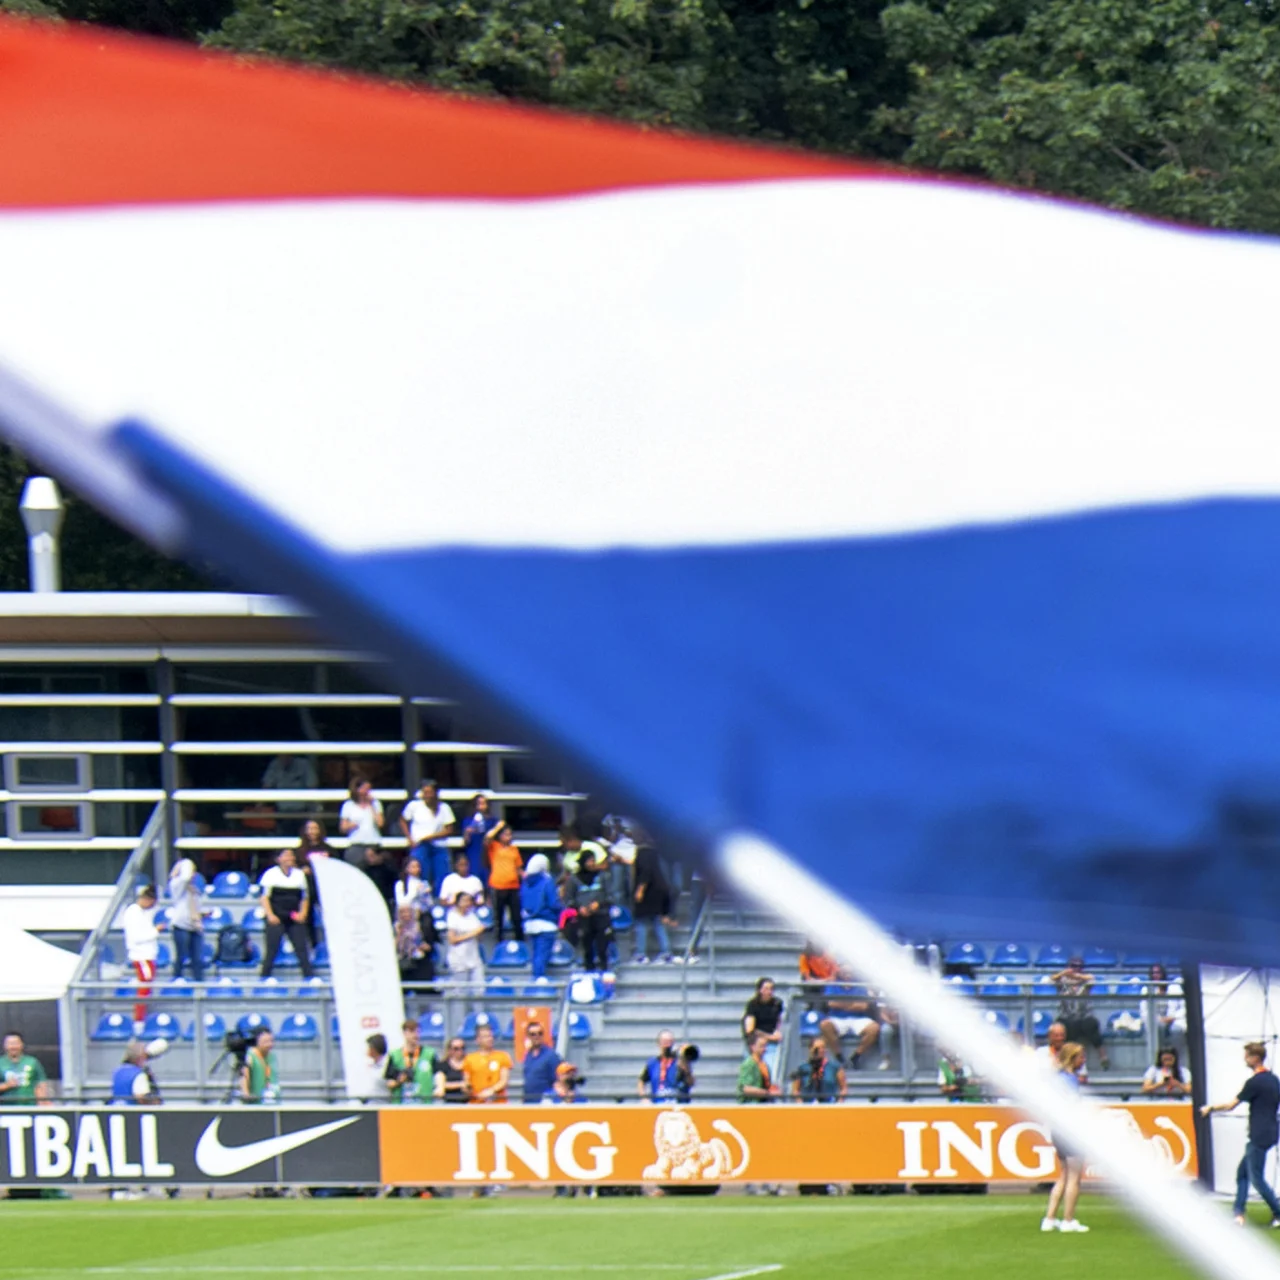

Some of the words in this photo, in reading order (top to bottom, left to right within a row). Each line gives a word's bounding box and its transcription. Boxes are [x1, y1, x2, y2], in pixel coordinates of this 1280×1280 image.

[0, 1114, 175, 1178] TBALL
[450, 1120, 619, 1180] ING
[896, 1120, 1058, 1178] ING
